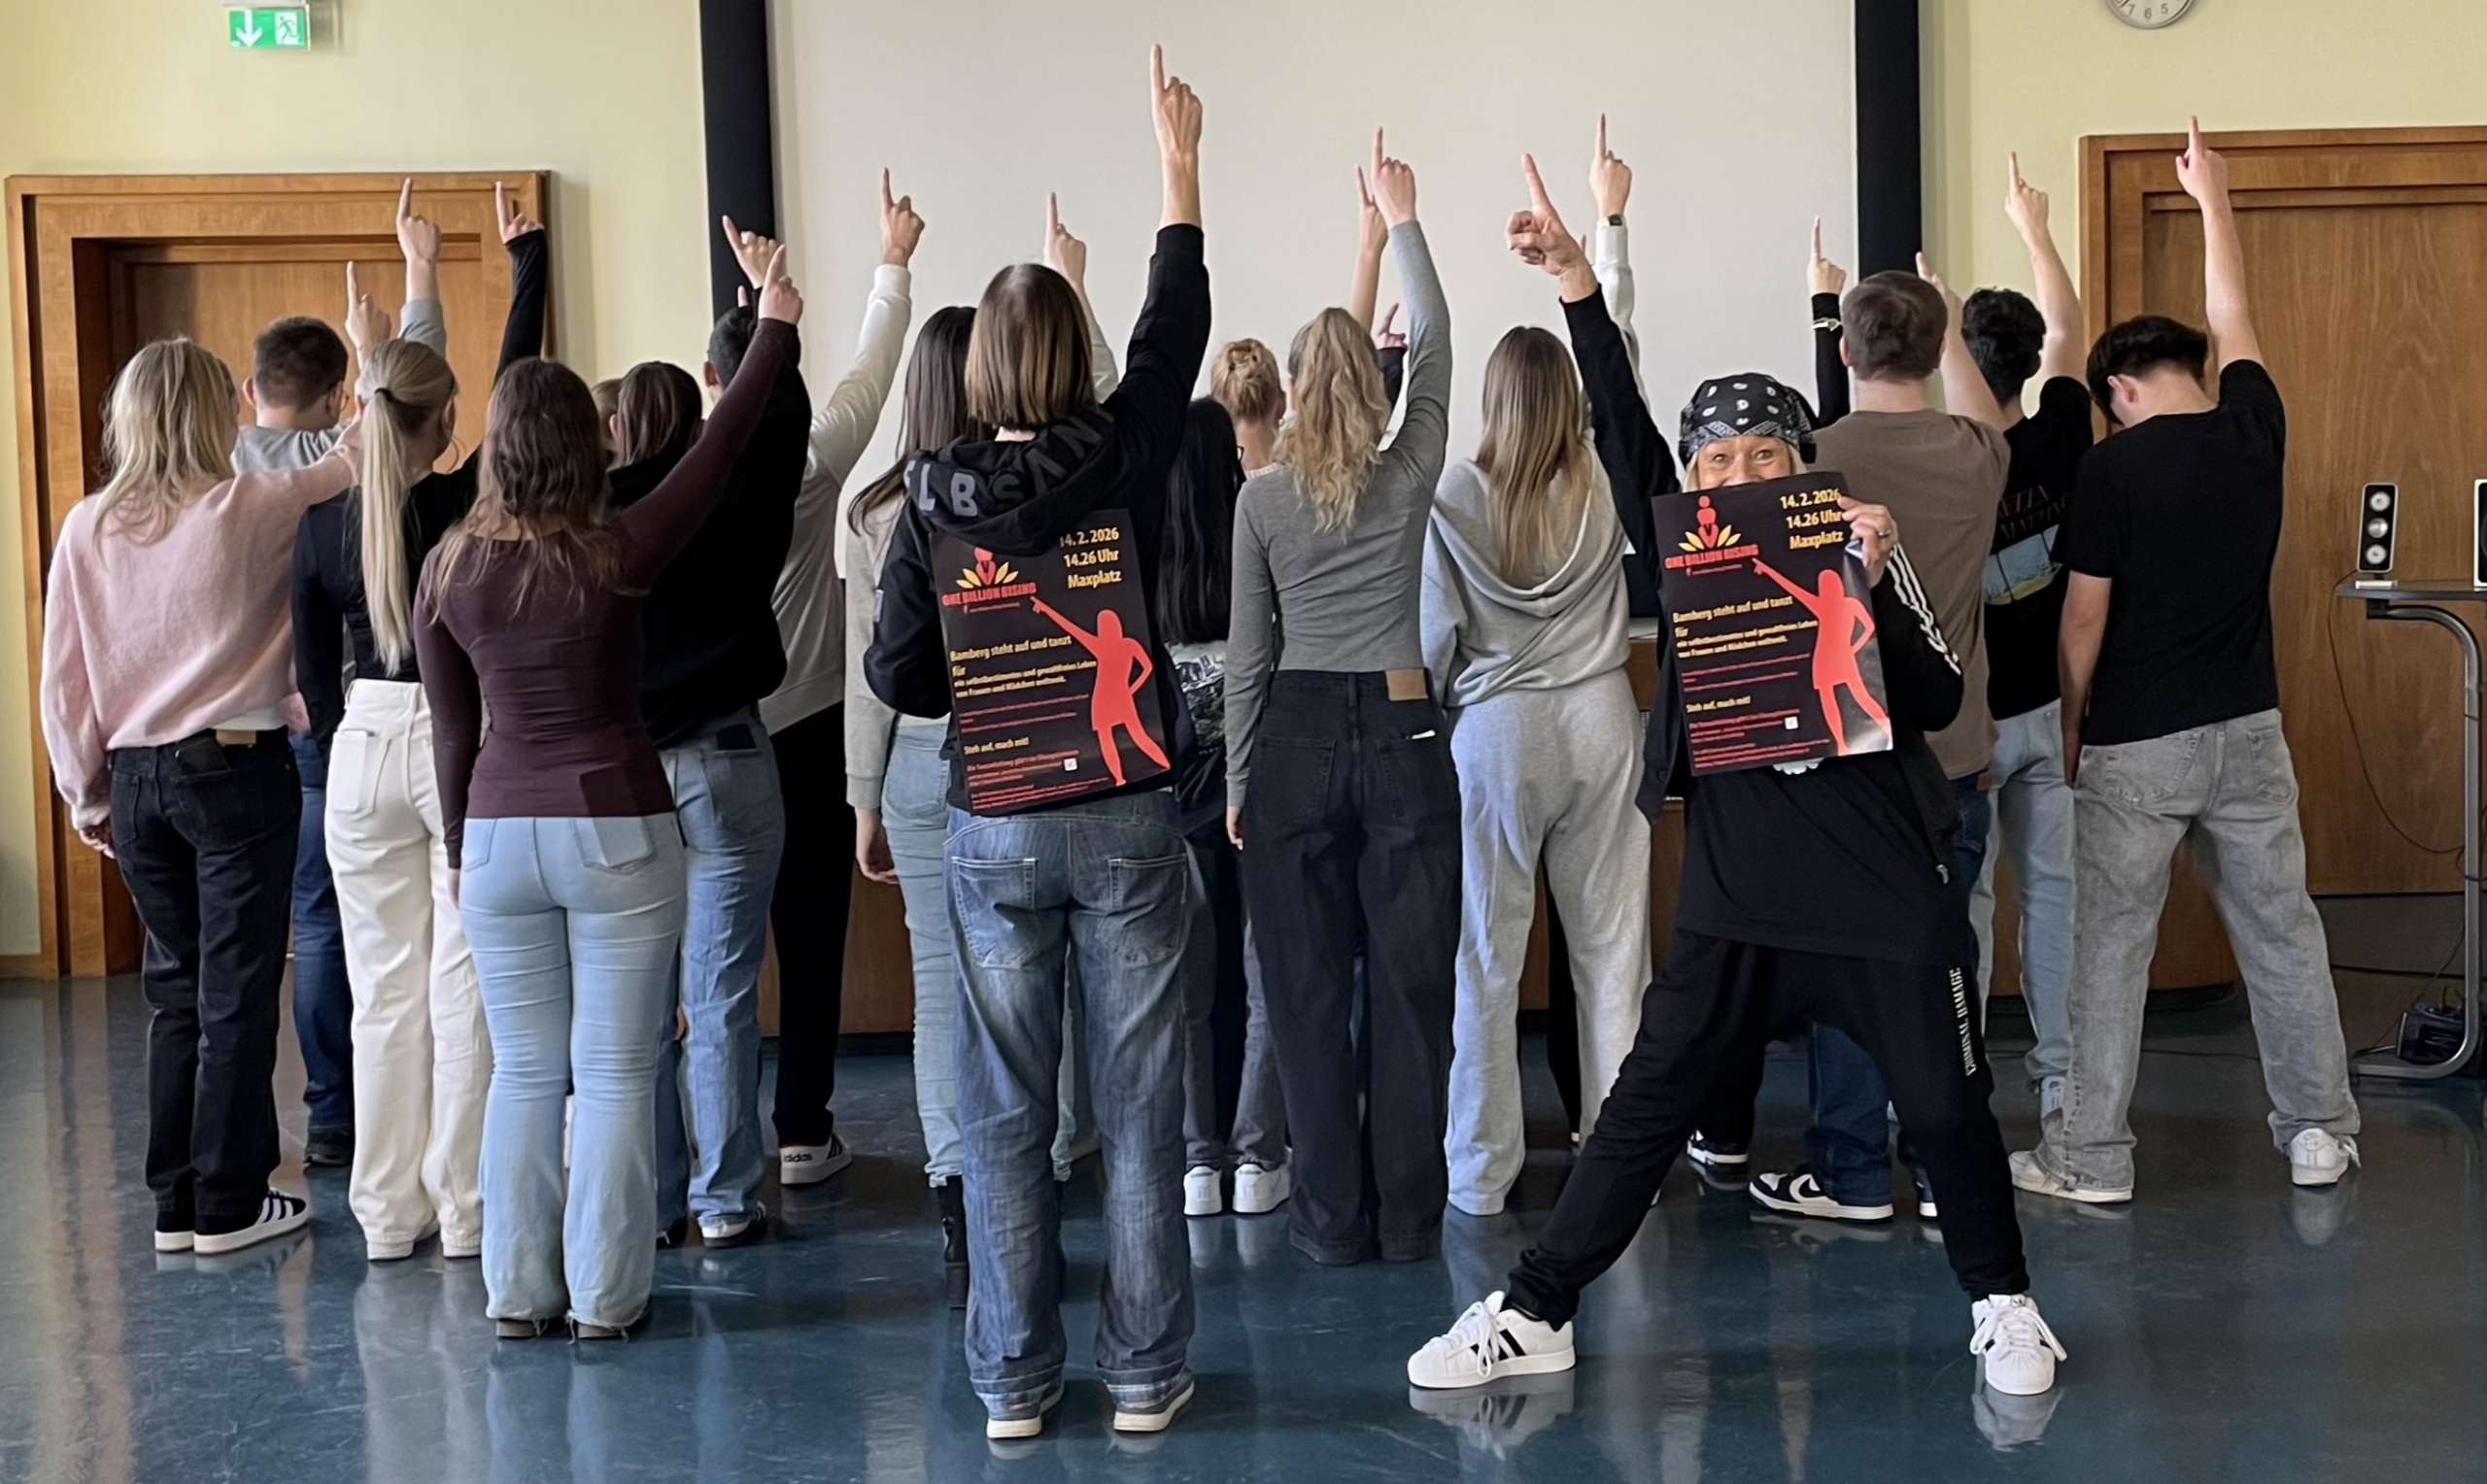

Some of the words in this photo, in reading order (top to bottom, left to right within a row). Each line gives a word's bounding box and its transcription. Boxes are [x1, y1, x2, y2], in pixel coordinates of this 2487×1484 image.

[2128, 4, 2135, 16] 7
[2144, 8, 2152, 19] 6
[2161, 4, 2168, 15] 5
[1786, 512, 1819, 528] 14.26
[1820, 509, 1842, 524] Uhr
[1789, 530, 1844, 550] Maxplatz
[1064, 550, 1097, 568] 14.26
[1097, 548, 1119, 563] Uhr
[1068, 569, 1122, 590] Maxplatz
[1673, 609, 1713, 624] Bamberg
[1713, 604, 1735, 617] steht
[1736, 601, 1751, 613] auf
[1752, 598, 1769, 611] und
[1770, 595, 1794, 608] tanzt
[1675, 625, 1689, 638] für
[949, 648, 990, 662] Bamberg
[991, 642, 1013, 657] steht
[1014, 639, 1030, 653] auf
[1030, 637, 1047, 651] und
[1048, 634, 1073, 648] tanzt
[952, 664, 967, 677] für
[1949, 967, 1968, 1018] DAMAGE
[1959, 1018, 1977, 1076] CRIMINAL
